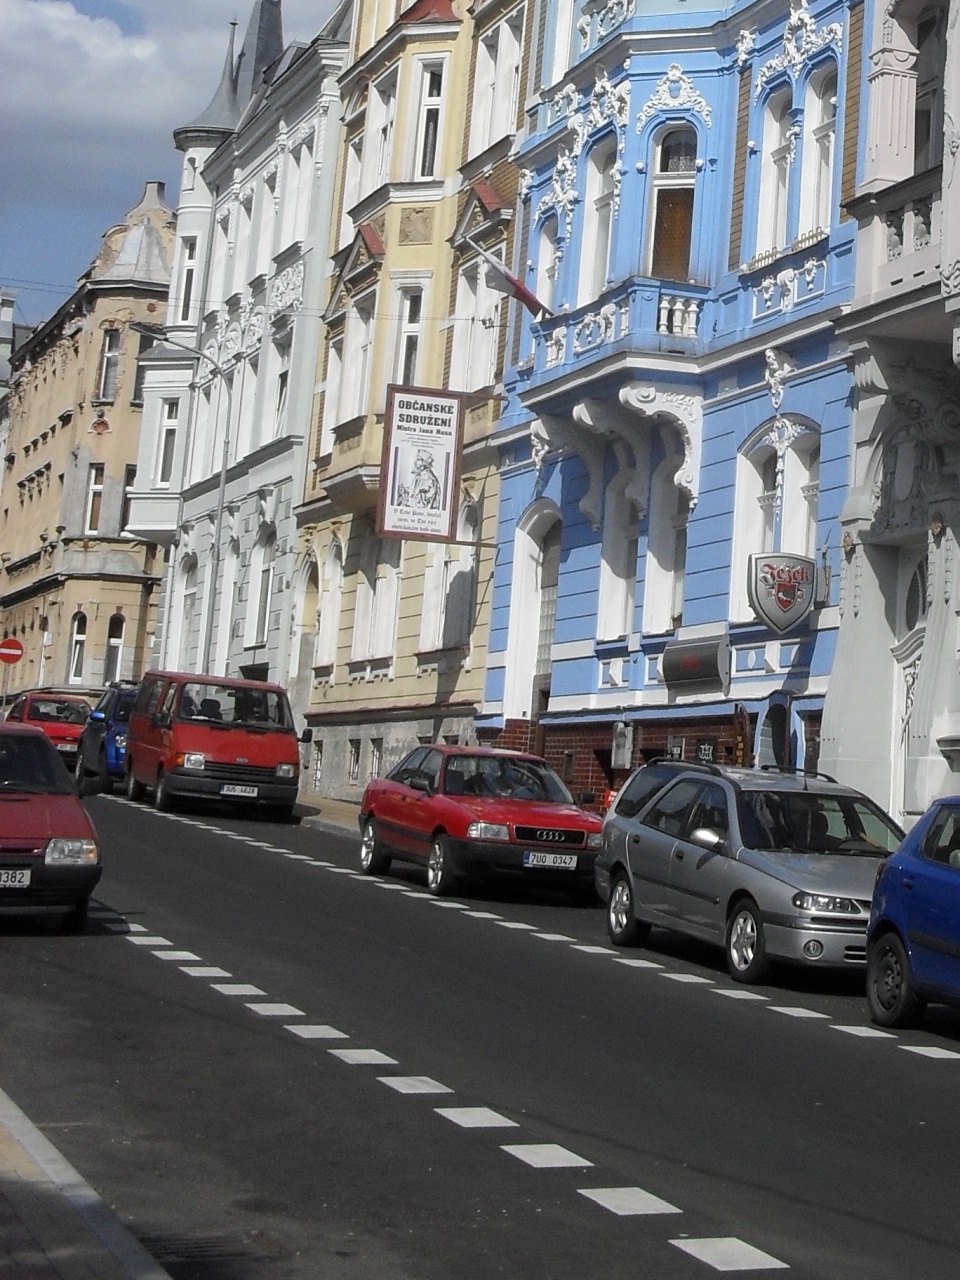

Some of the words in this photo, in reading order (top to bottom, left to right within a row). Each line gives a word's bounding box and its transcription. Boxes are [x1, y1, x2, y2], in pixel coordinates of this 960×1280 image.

[398, 400, 454, 414] OBČANSKÉ
[398, 413, 452, 427] SDRUŽENÍ
[552, 856, 573, 865] 0347
